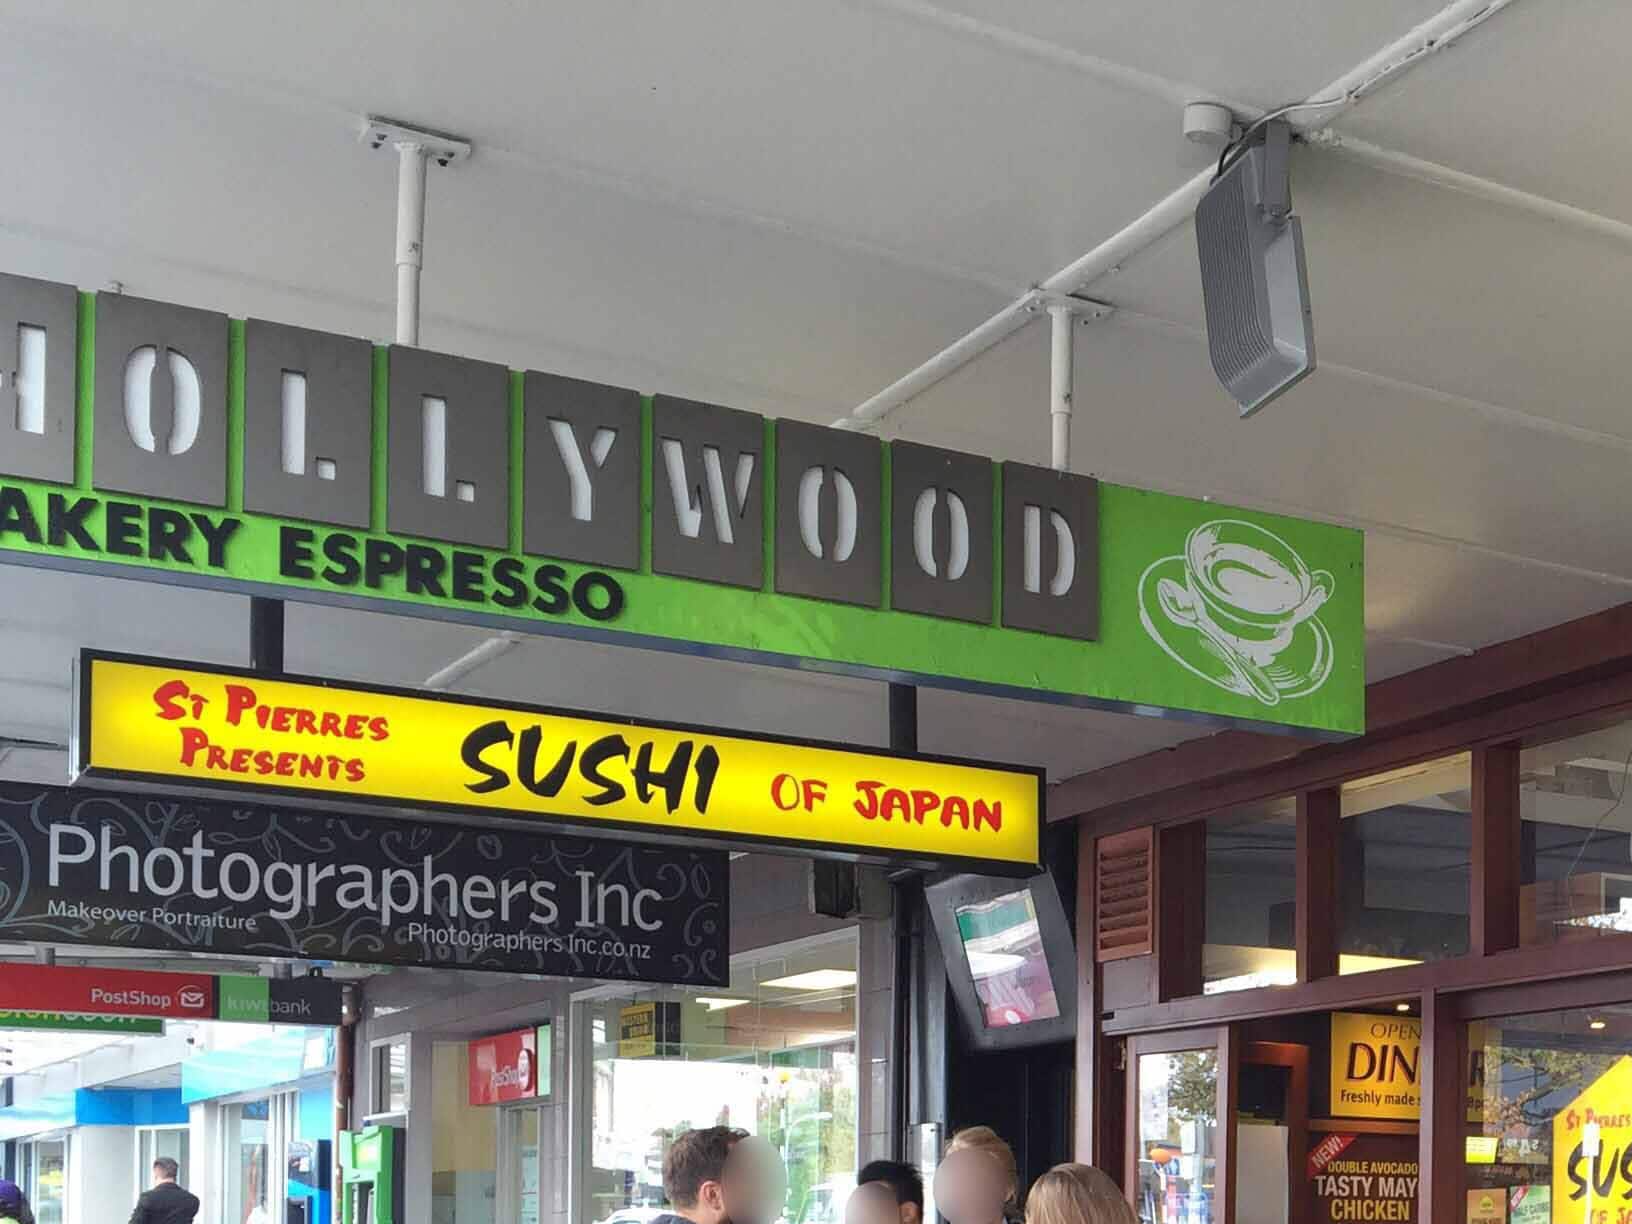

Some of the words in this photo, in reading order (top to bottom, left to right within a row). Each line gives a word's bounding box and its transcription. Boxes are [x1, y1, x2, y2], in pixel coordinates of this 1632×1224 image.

[280, 527, 625, 622] ESPRESSO
[461, 721, 720, 815] SUSHI
[772, 774, 827, 812] OF
[854, 780, 1002, 833] JAPAN
[48, 823, 559, 927] Photographers
[575, 870, 662, 931] Inc
[47, 900, 146, 924] Makeover
[152, 907, 257, 931] Portraiture
[91, 988, 171, 1009] PostShop
[1370, 1022, 1421, 1041] OPEN
[1347, 1043, 1421, 1085] DIN
[1341, 1089, 1381, 1106] Freshly
[1384, 1092, 1415, 1107] made
[1328, 1161, 1368, 1174] DOUBLE
[1370, 1161, 1418, 1175] AVOCADO
[1315, 1176, 1374, 1198] TASTY
[1331, 1200, 1410, 1221] CHICKEN
